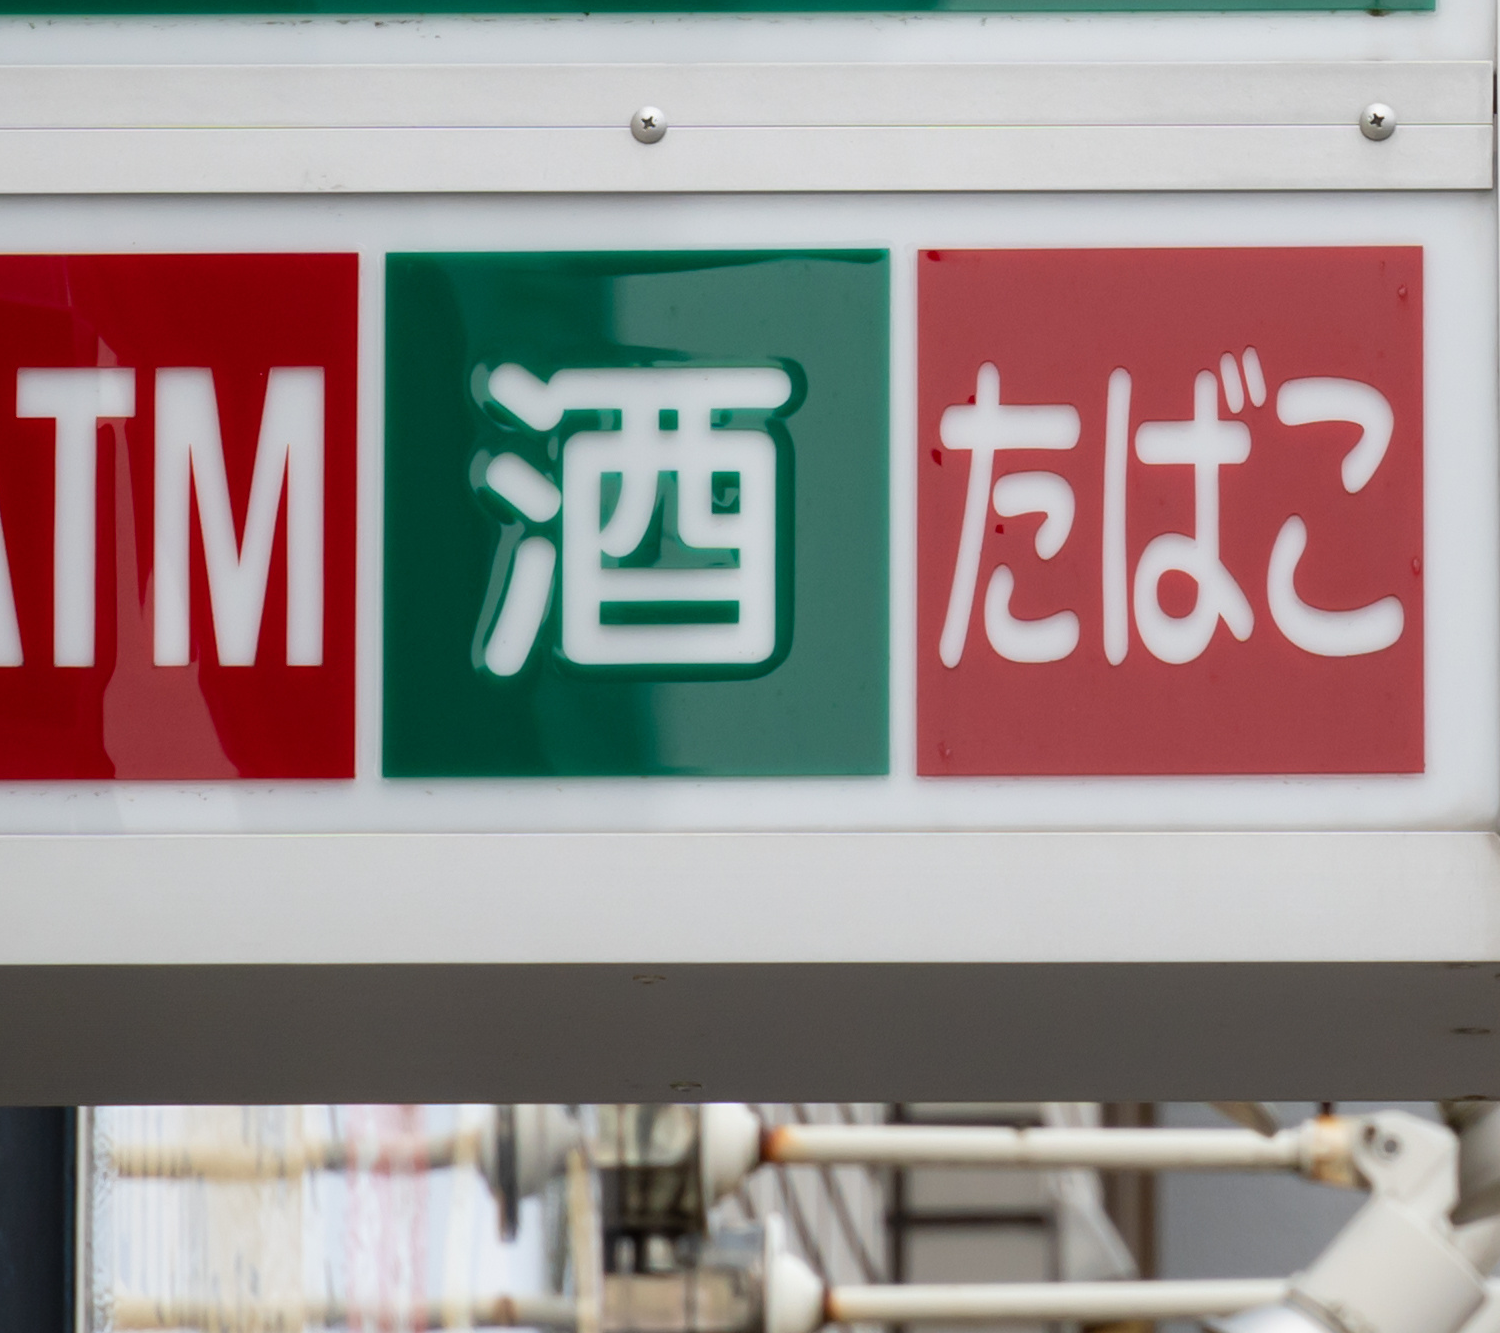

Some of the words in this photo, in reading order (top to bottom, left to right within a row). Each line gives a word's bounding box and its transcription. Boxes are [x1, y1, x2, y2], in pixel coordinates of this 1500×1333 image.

[486, 361, 794, 678] 酒
[939, 344, 1406, 670] たばこ
